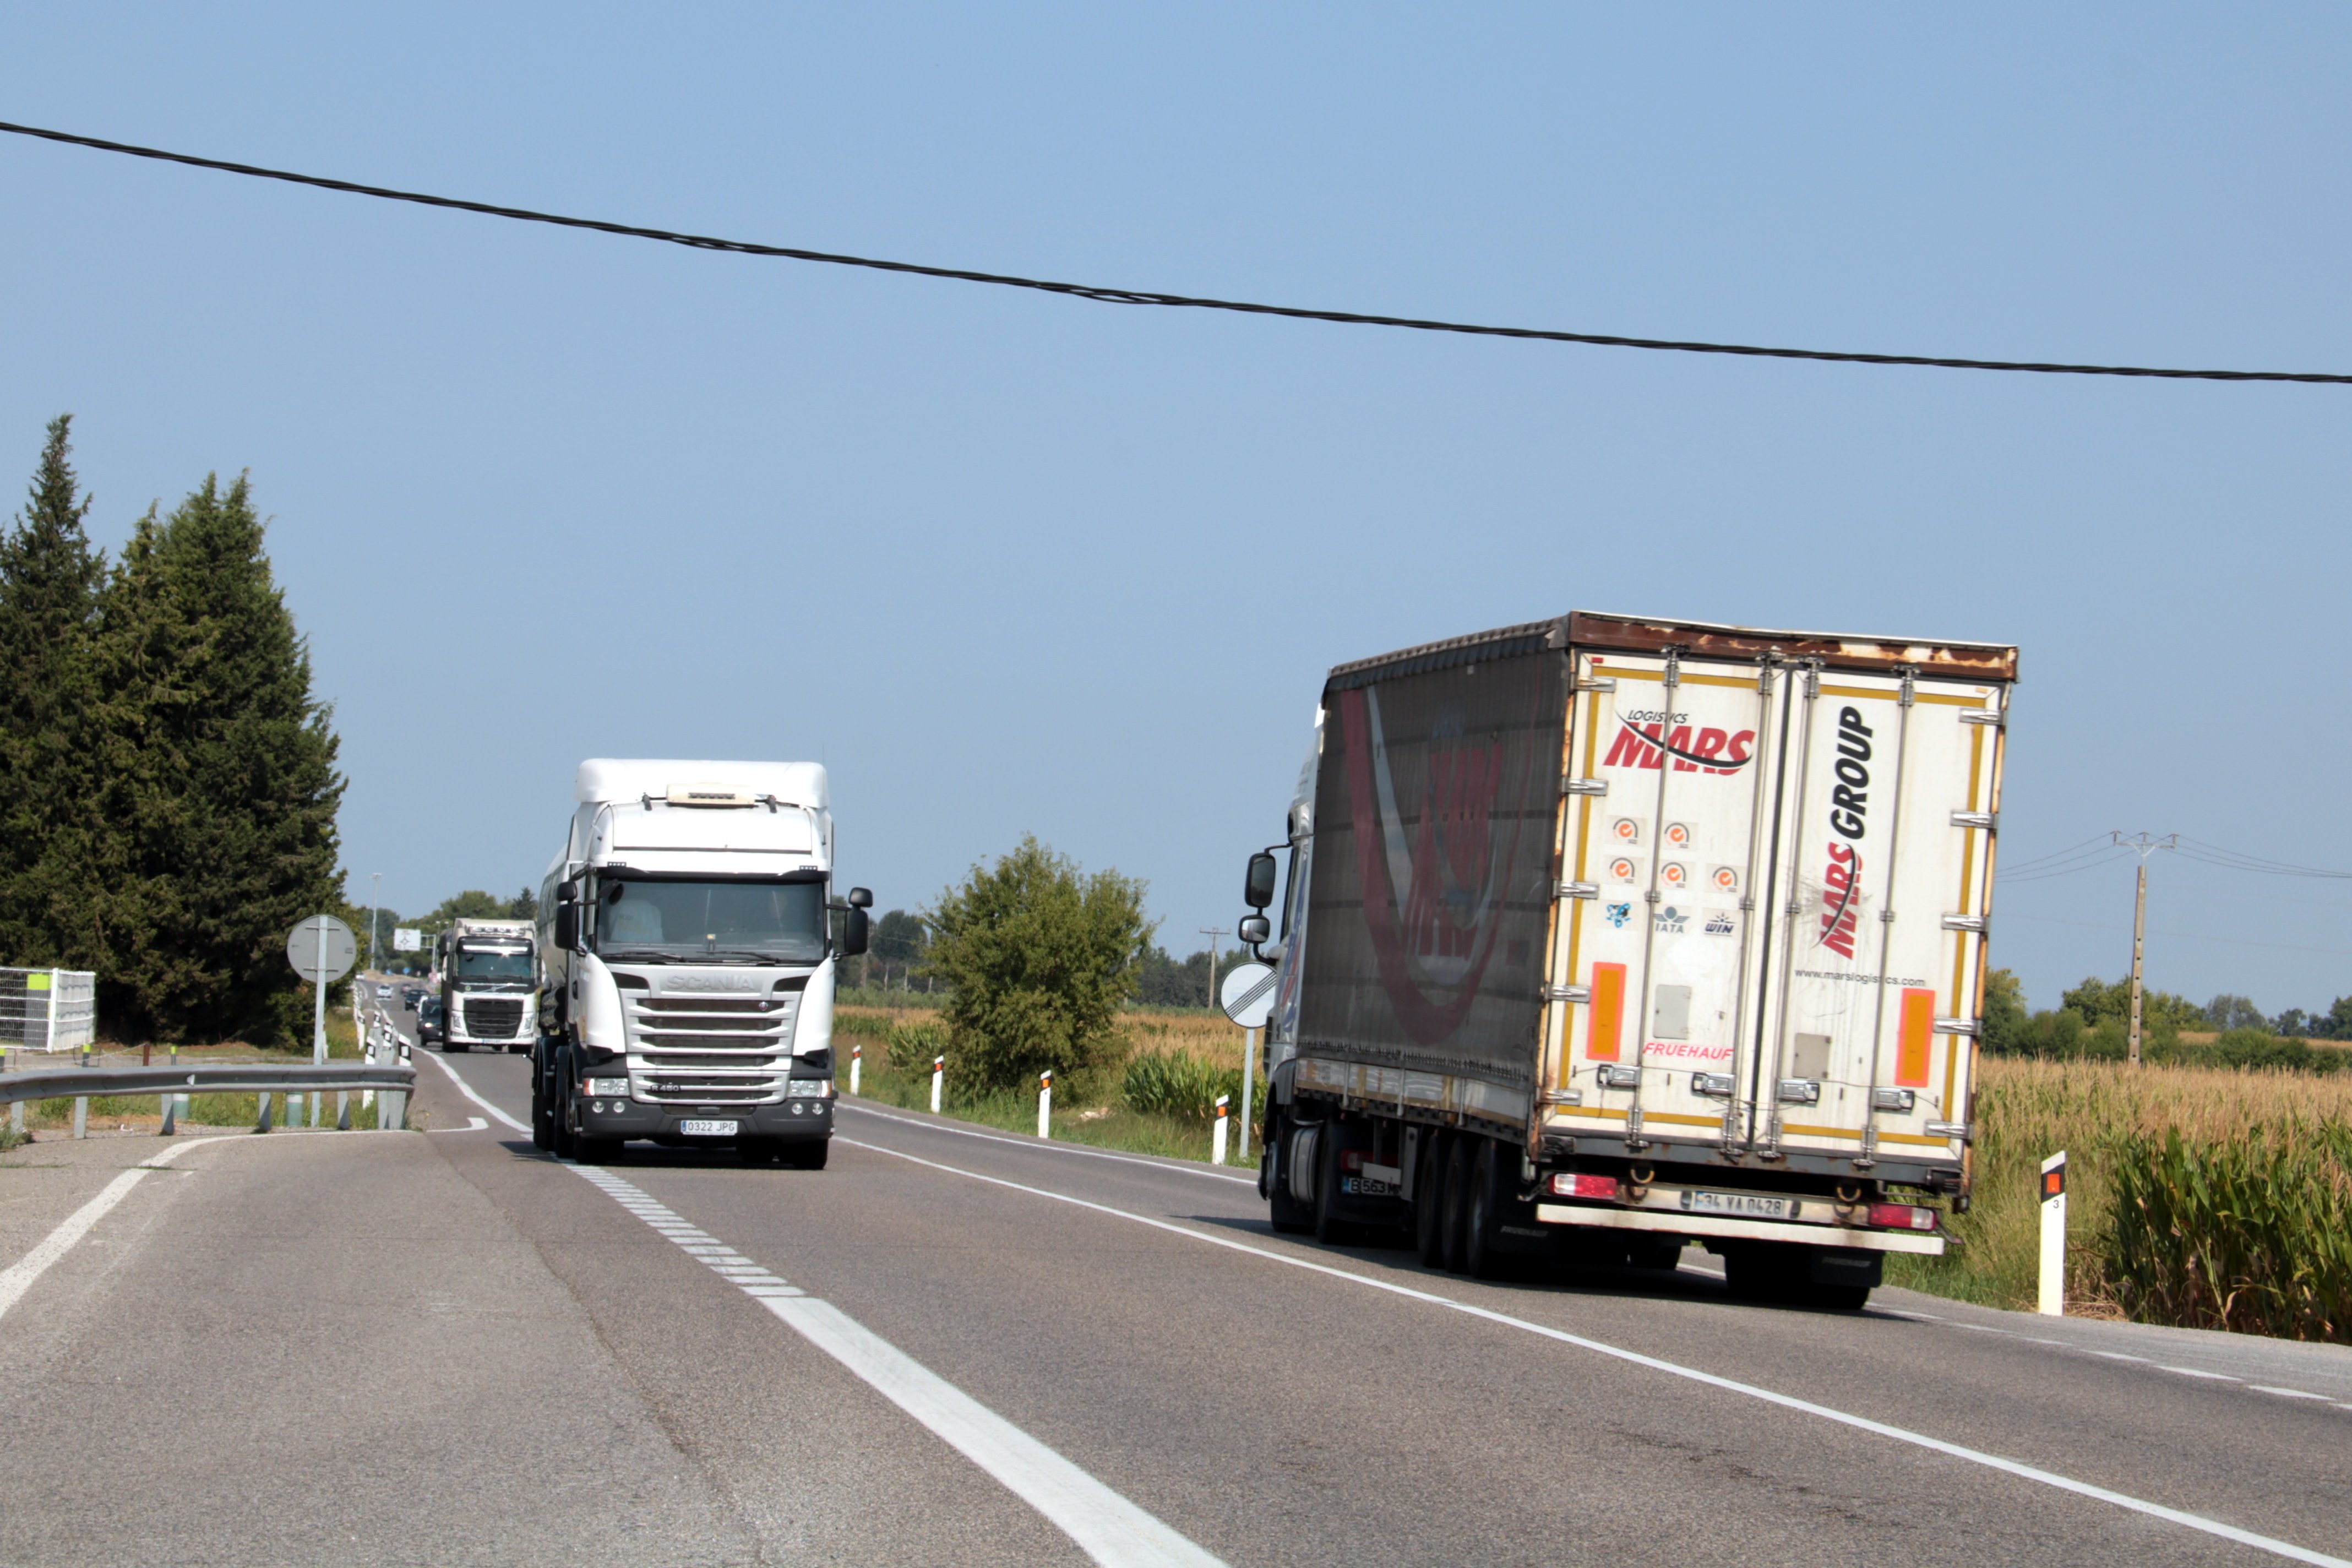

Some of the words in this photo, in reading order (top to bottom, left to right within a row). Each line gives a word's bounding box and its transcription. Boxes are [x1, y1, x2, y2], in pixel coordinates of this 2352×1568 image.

[1603, 722, 1756, 776] MARS
[1831, 706, 1874, 840] GROUP
[1820, 842, 1863, 960] MARS
[1655, 923, 1684, 934] IATA
[1706, 923, 1734, 934] WIN
[667, 975, 755, 990] SCANIA
[1642, 1043, 1734, 1060] FRUEHAUF
[688, 1122, 713, 1131] 0322
[717, 1122, 734, 1131] JPG
[1351, 1179, 1361, 1192] B
[1363, 1179, 1386, 1193] 563
[1706, 1194, 1720, 1208] 34
[1727, 1196, 1743, 1211] VA
[1747, 1198, 1782, 1215] 0428
[2053, 1200, 2059, 1208] 3
